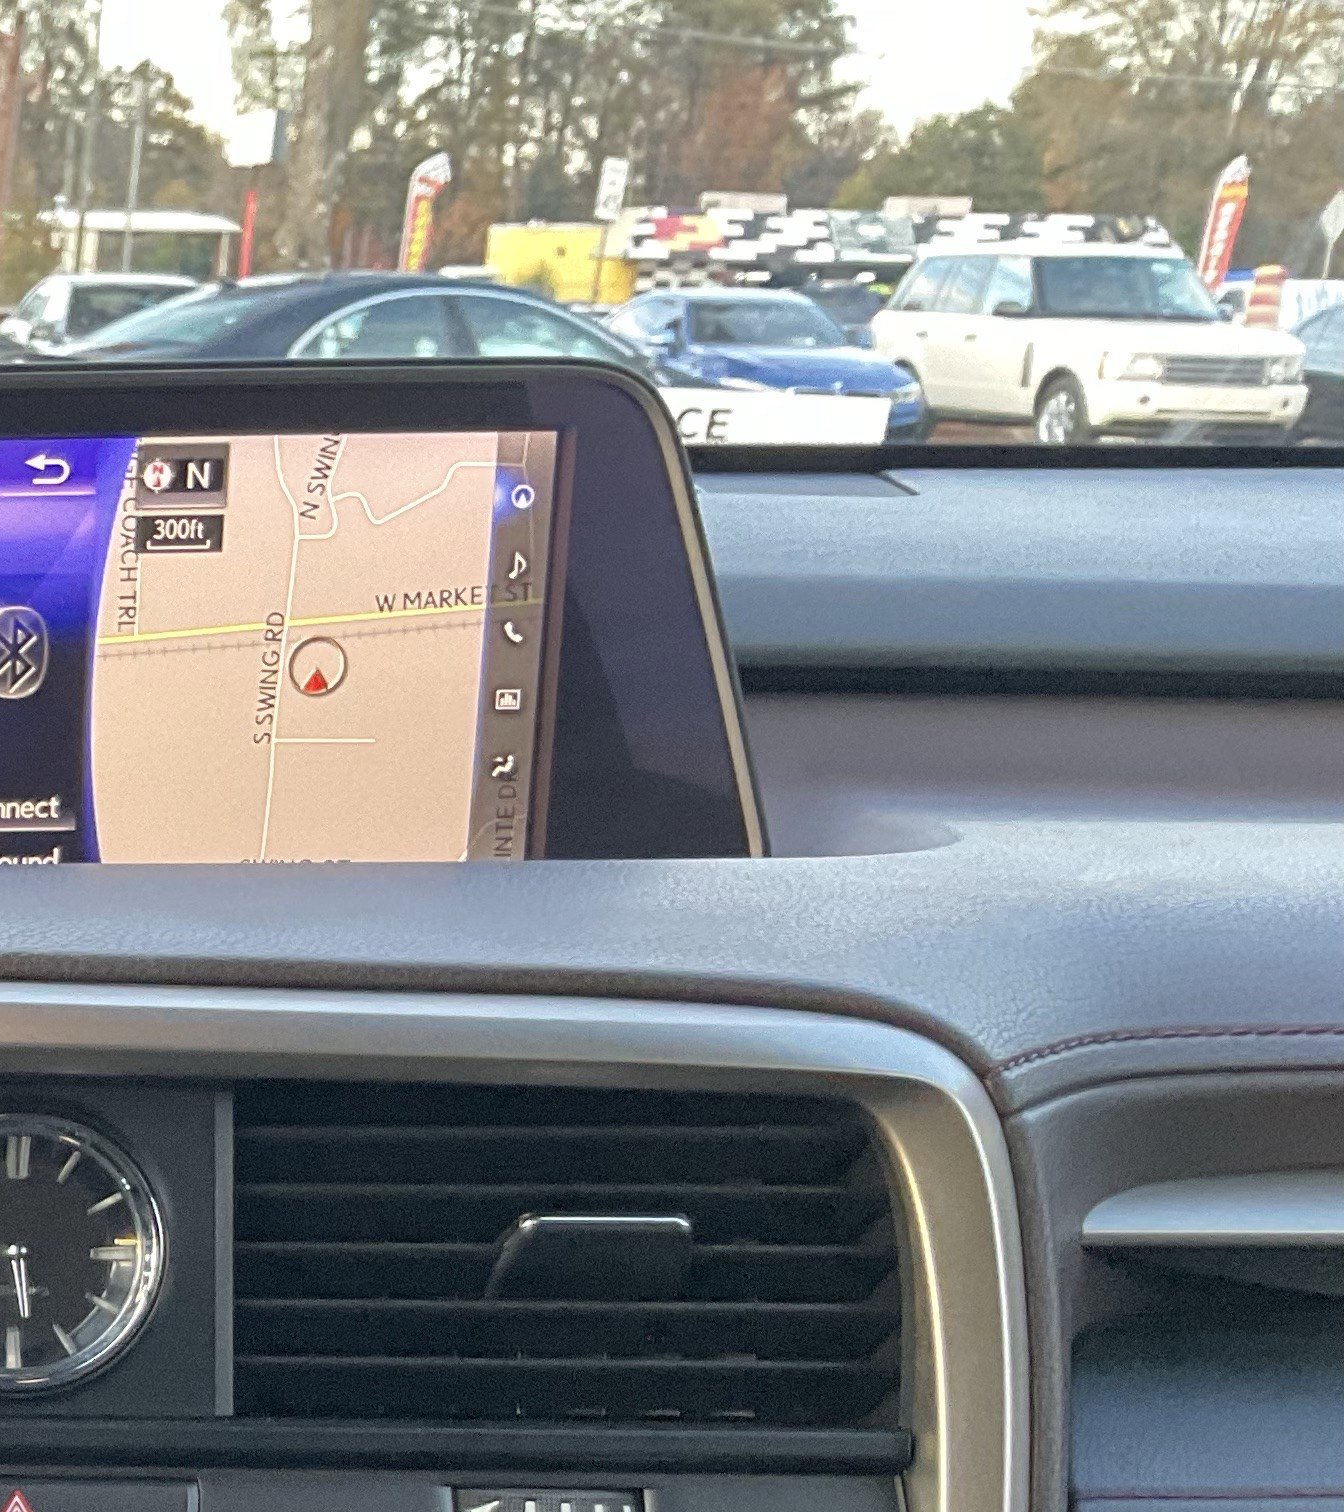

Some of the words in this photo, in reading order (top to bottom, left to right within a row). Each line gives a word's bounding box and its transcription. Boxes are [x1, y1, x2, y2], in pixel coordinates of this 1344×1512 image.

[186, 461, 211, 490] N
[306, 436, 341, 496] SWIN
[298, 501, 320, 520] N
[152, 518, 204, 540] 300ft
[117, 590, 137, 632] TRL
[375, 593, 397, 613] W
[263, 611, 285, 642] RD
[255, 650, 281, 725] SWING
[253, 732, 272, 745] S
